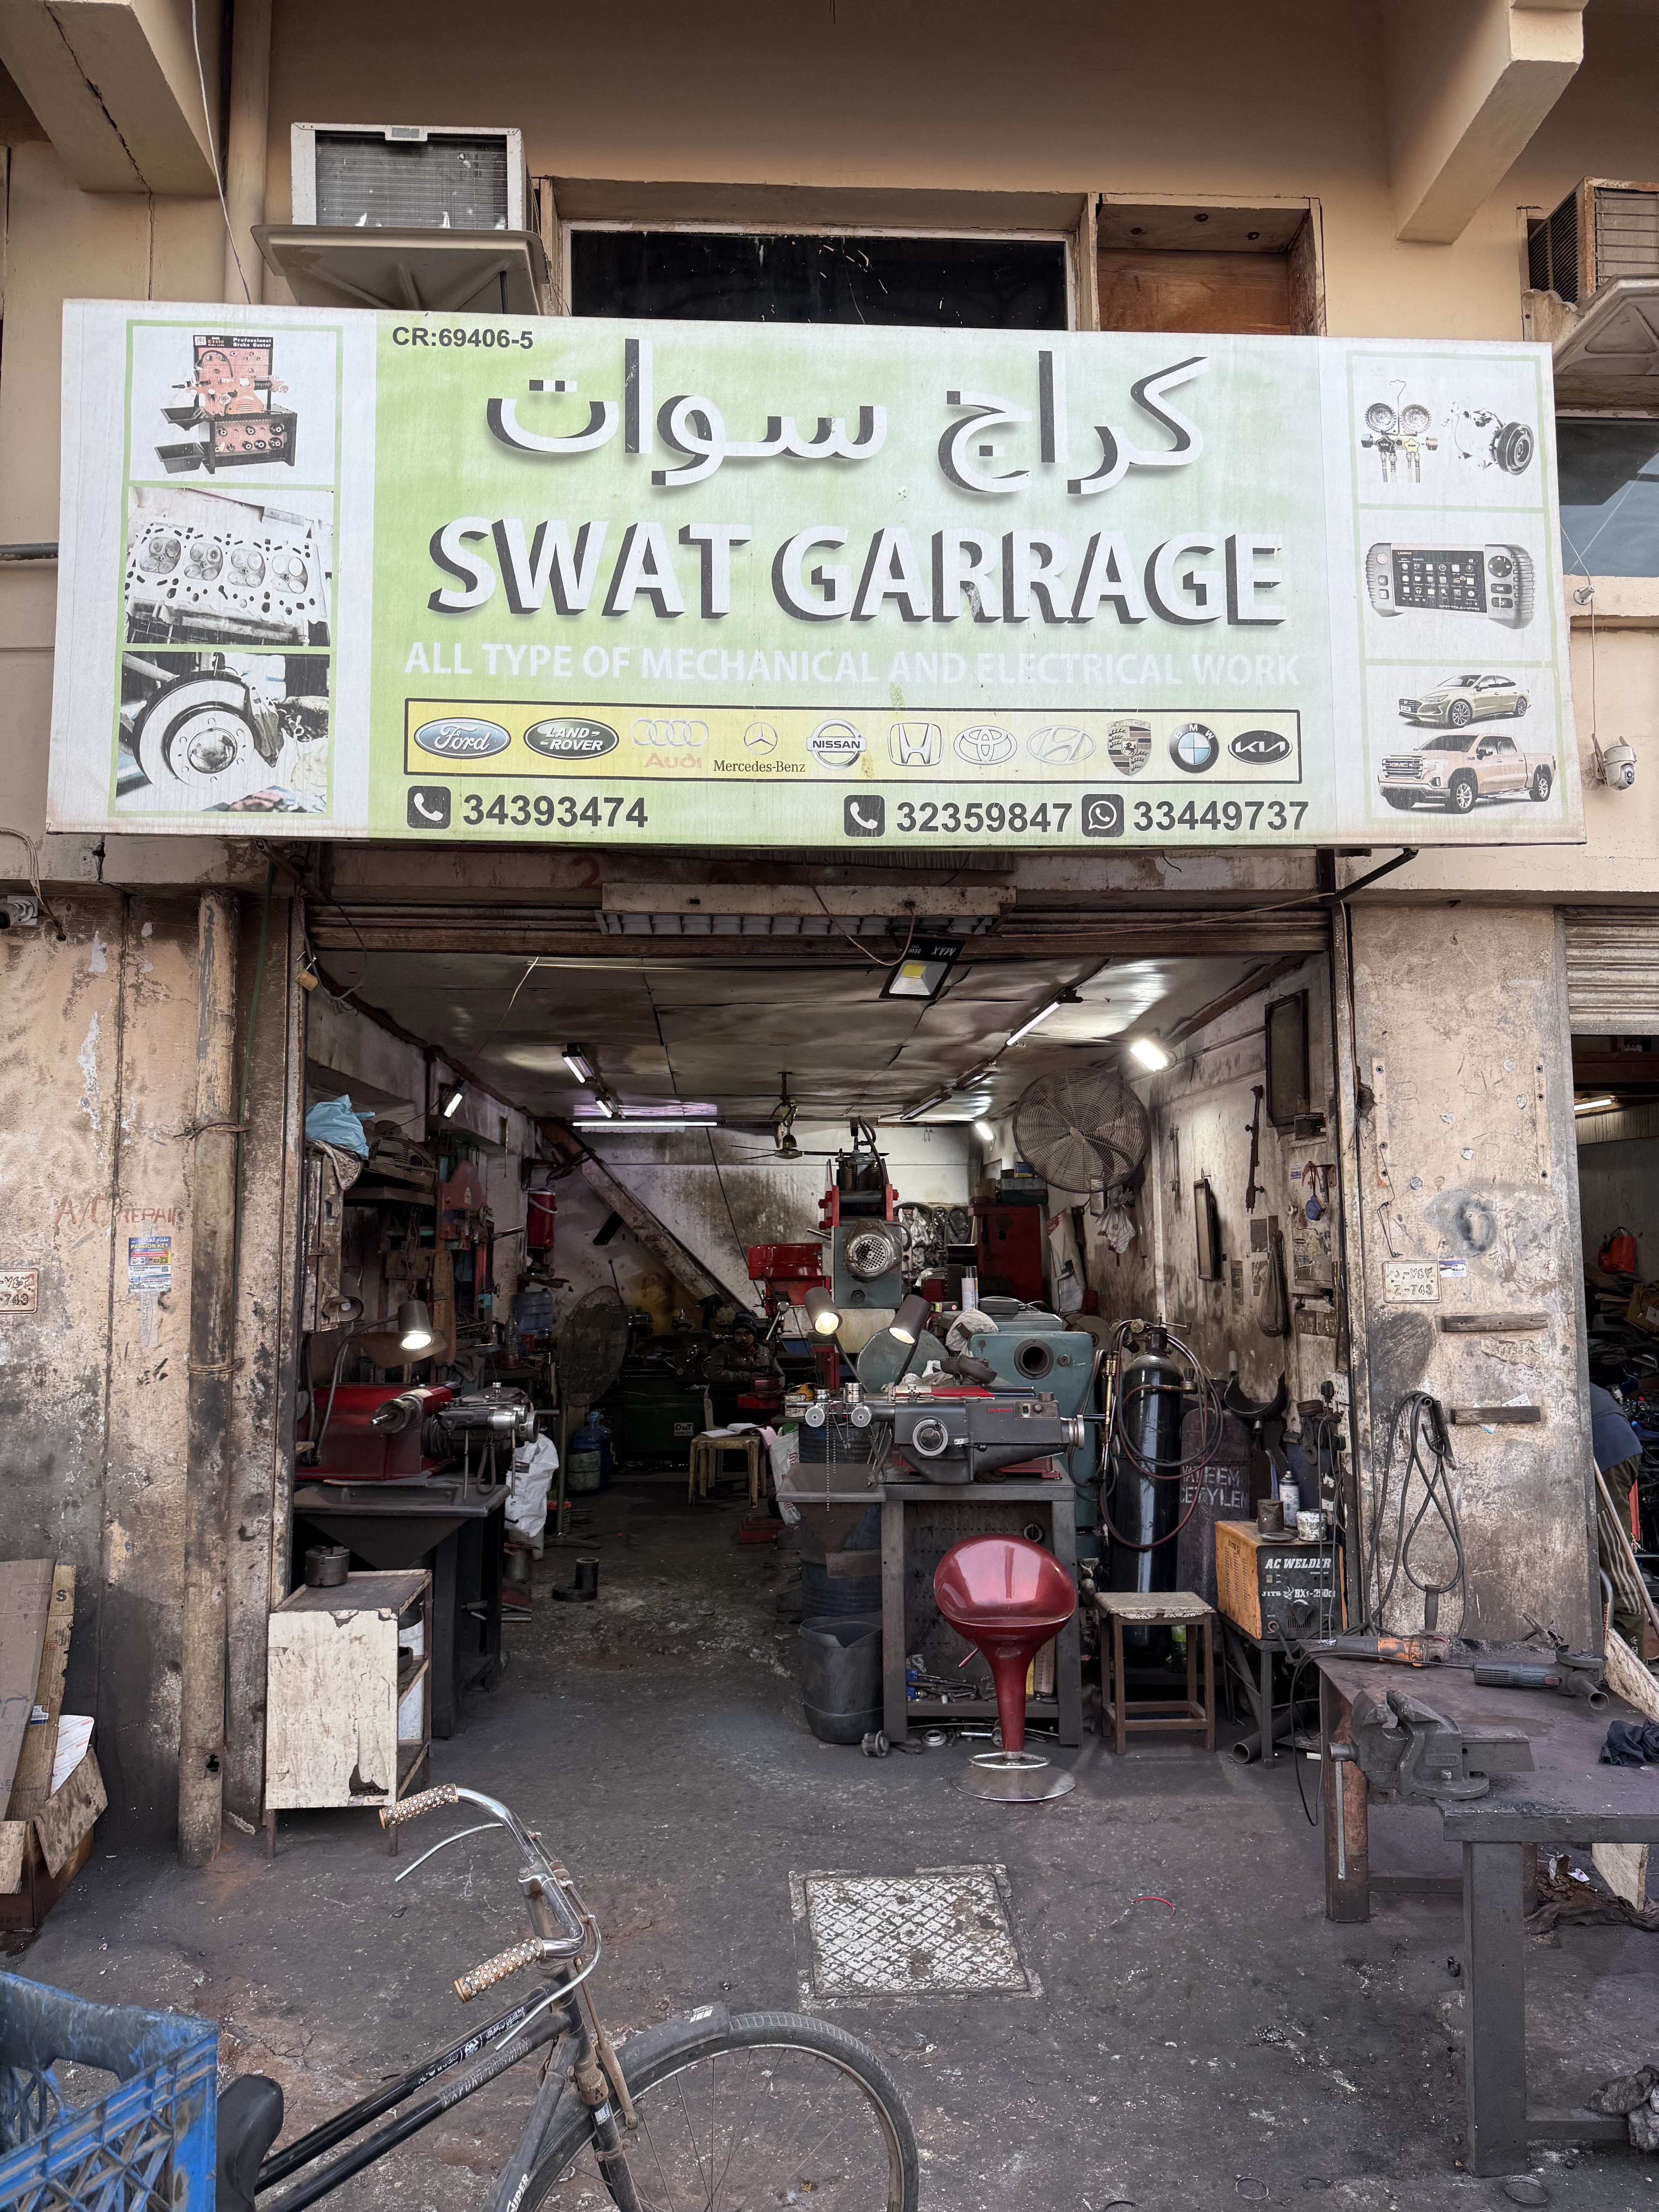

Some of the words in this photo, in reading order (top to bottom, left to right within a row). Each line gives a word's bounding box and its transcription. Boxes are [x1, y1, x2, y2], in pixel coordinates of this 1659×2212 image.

[392, 326, 533, 349] CR:69406-5
[486, 338, 888, 486] سوات
[938, 350, 1208, 495] كراج
[427, 516, 752, 620] SWAT
[771, 525, 1287, 626] GARRAGE
[405, 641, 472, 675] ALL
[481, 643, 572, 678] TYPE
[582, 646, 630, 678] OF
[641, 647, 879, 683] MECHANICAL
[890, 651, 967, 683] AND
[977, 652, 1183, 685] ELECTRICAL
[1192, 654, 1301, 685] WORK
[434, 724, 490, 750] Ford
[546, 727, 590, 738] LAND
[1175, 724, 1215, 740] BMW
[550, 739, 603, 750] ROVER
[812, 740, 860, 749] NISSAN
[1235, 741, 1285, 752] KIA
[644, 752, 702, 769] Audi
[713, 760, 806, 773] Mercedes-Benz
[463, 794, 648, 828] 34393474
[896, 802, 1072, 833] 32359847
[1133, 800, 1309, 831] 33449737
[931, 946, 956, 956] MAX
[1264, 1558, 1282, 1569] AC
[56, 1589, 67, 1602] S
[506, 2173, 529, 2212] SUPER
